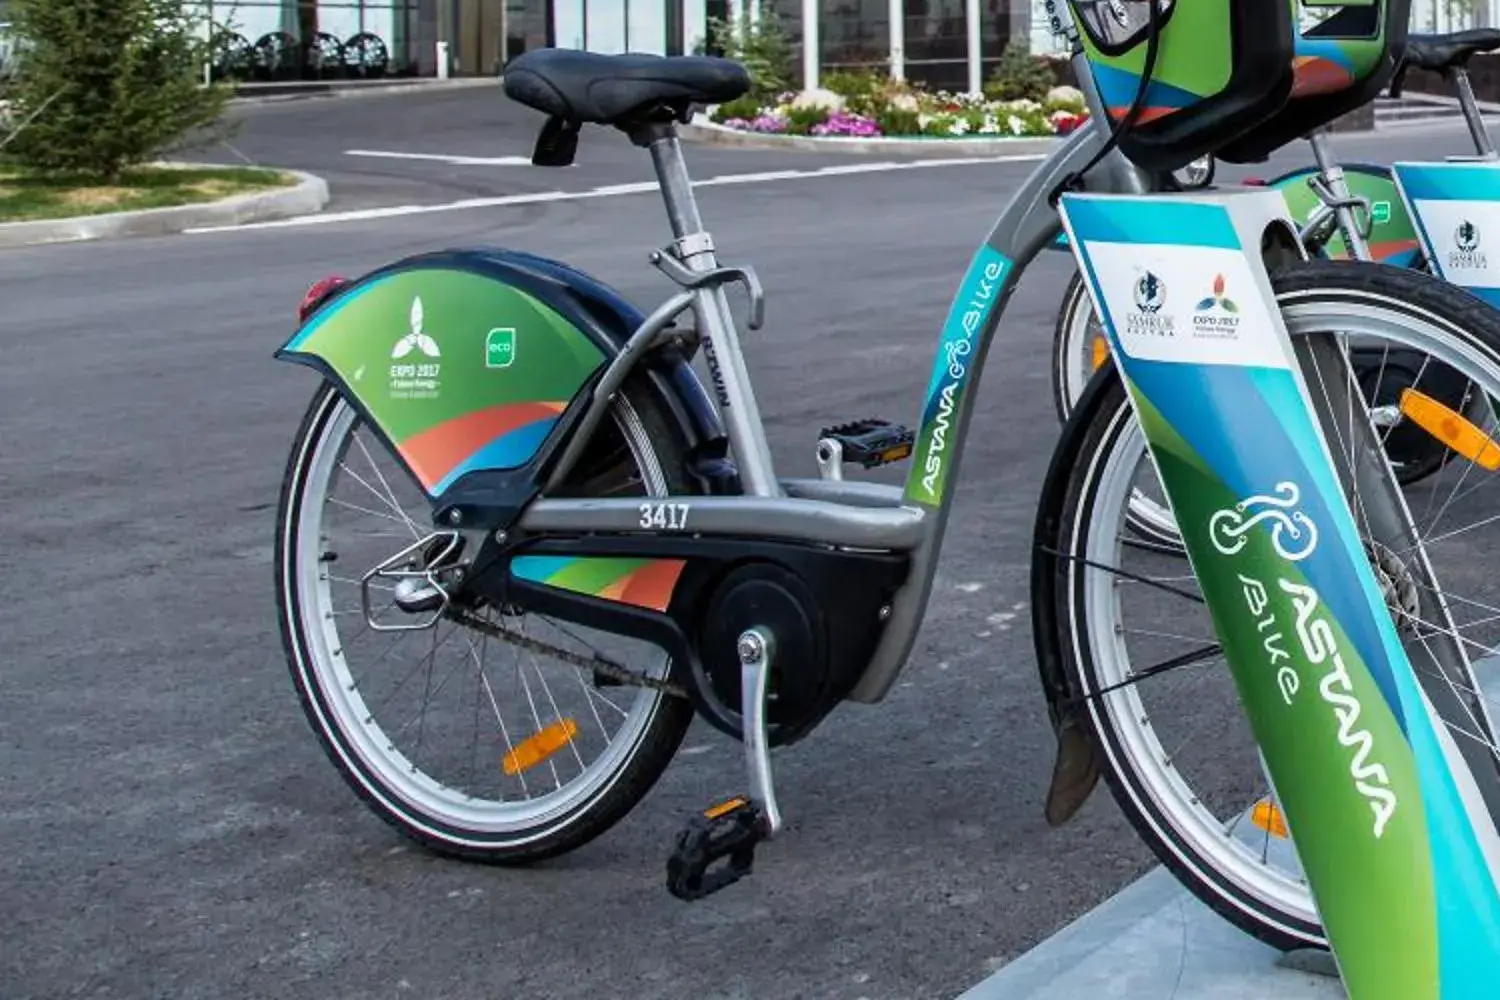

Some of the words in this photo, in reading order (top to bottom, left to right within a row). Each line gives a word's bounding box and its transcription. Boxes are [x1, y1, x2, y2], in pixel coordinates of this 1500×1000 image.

[1193, 315, 1216, 325] EXPO
[488, 343, 511, 353] eco
[391, 364, 415, 377] EXPO
[417, 364, 440, 377] 2017
[922, 382, 958, 496] ASTANA
[640, 504, 690, 529] 3417
[1279, 578, 1396, 838] ASTANA
